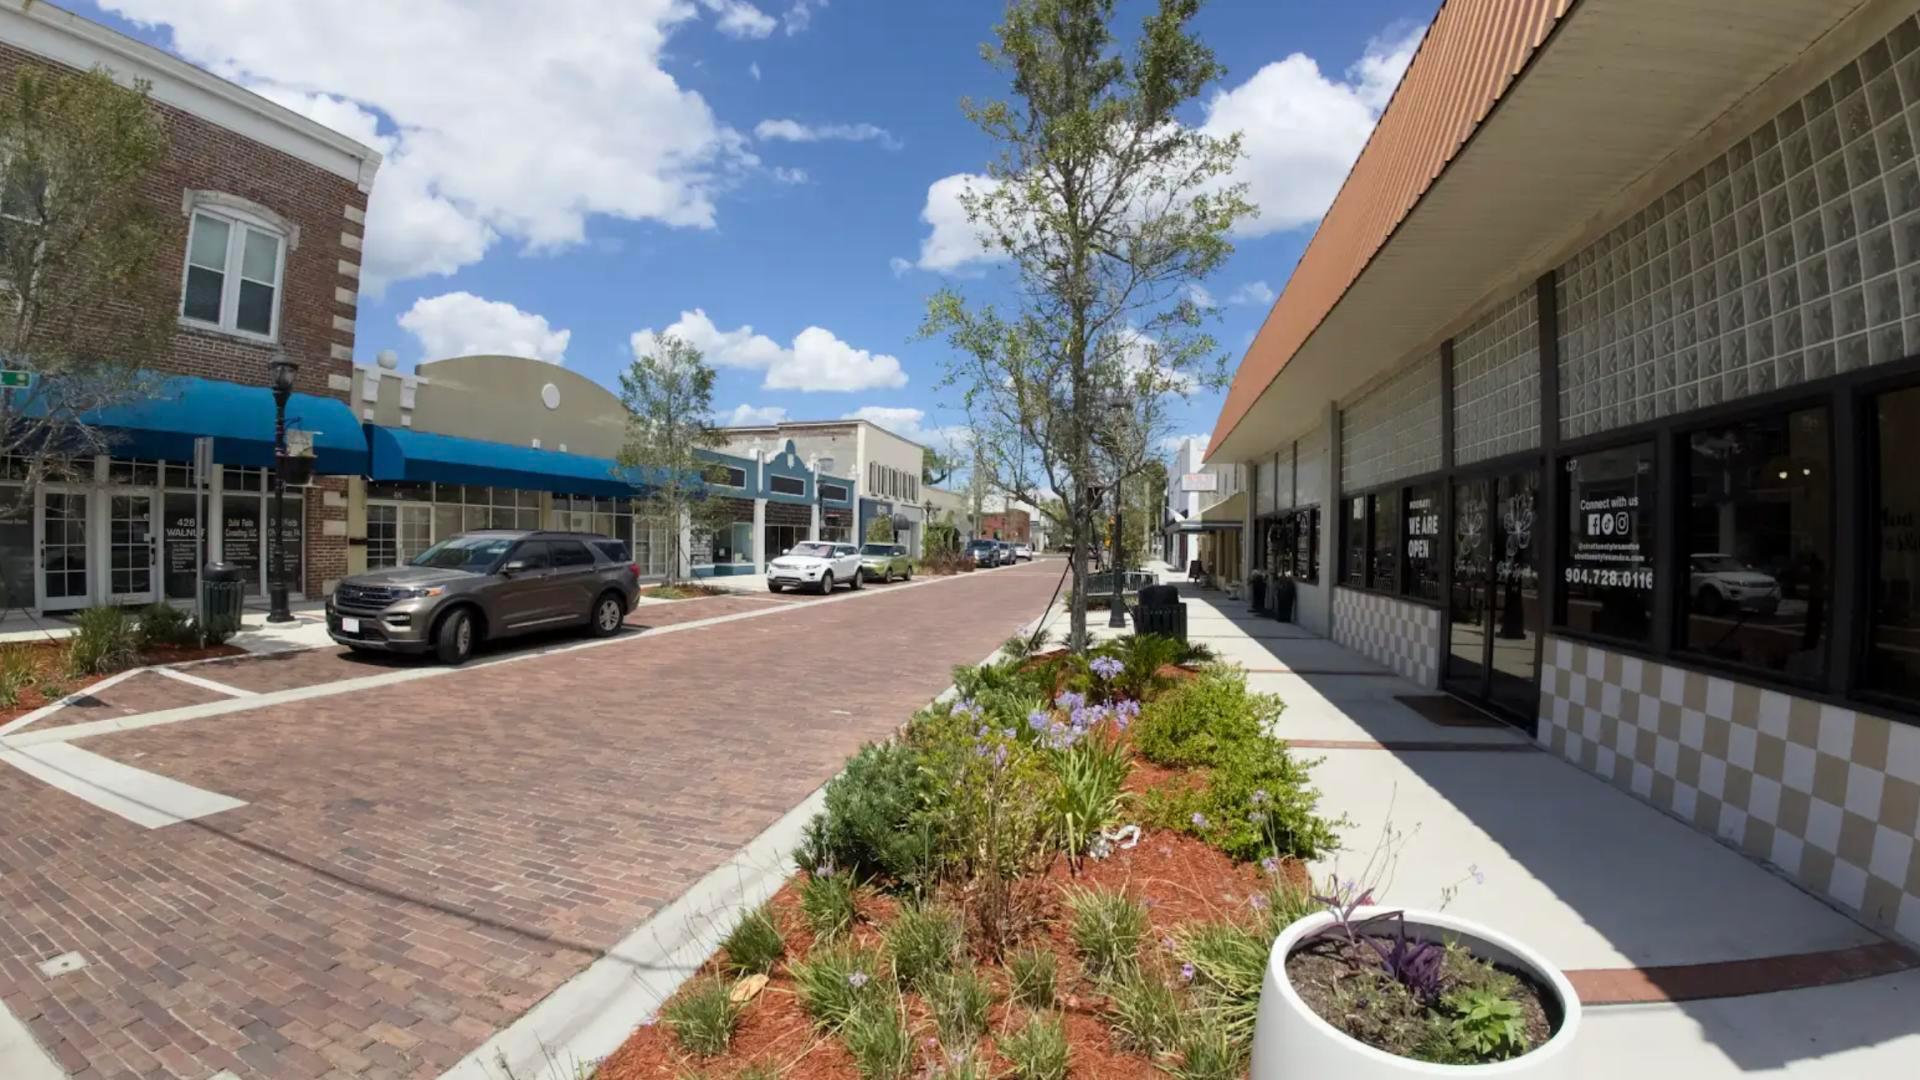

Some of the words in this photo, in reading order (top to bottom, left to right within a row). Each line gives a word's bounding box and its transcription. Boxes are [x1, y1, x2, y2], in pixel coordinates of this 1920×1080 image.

[1580, 498, 1610, 511] Connect
[1611, 496, 1627, 508] with
[1628, 496, 1639, 507] us
[176, 518, 196, 527] 428
[1408, 516, 1421, 535] WE
[1421, 514, 1439, 535] ARE
[1407, 539, 1430, 559] OPEN
[1565, 567, 1653, 590] 904.728.0116
